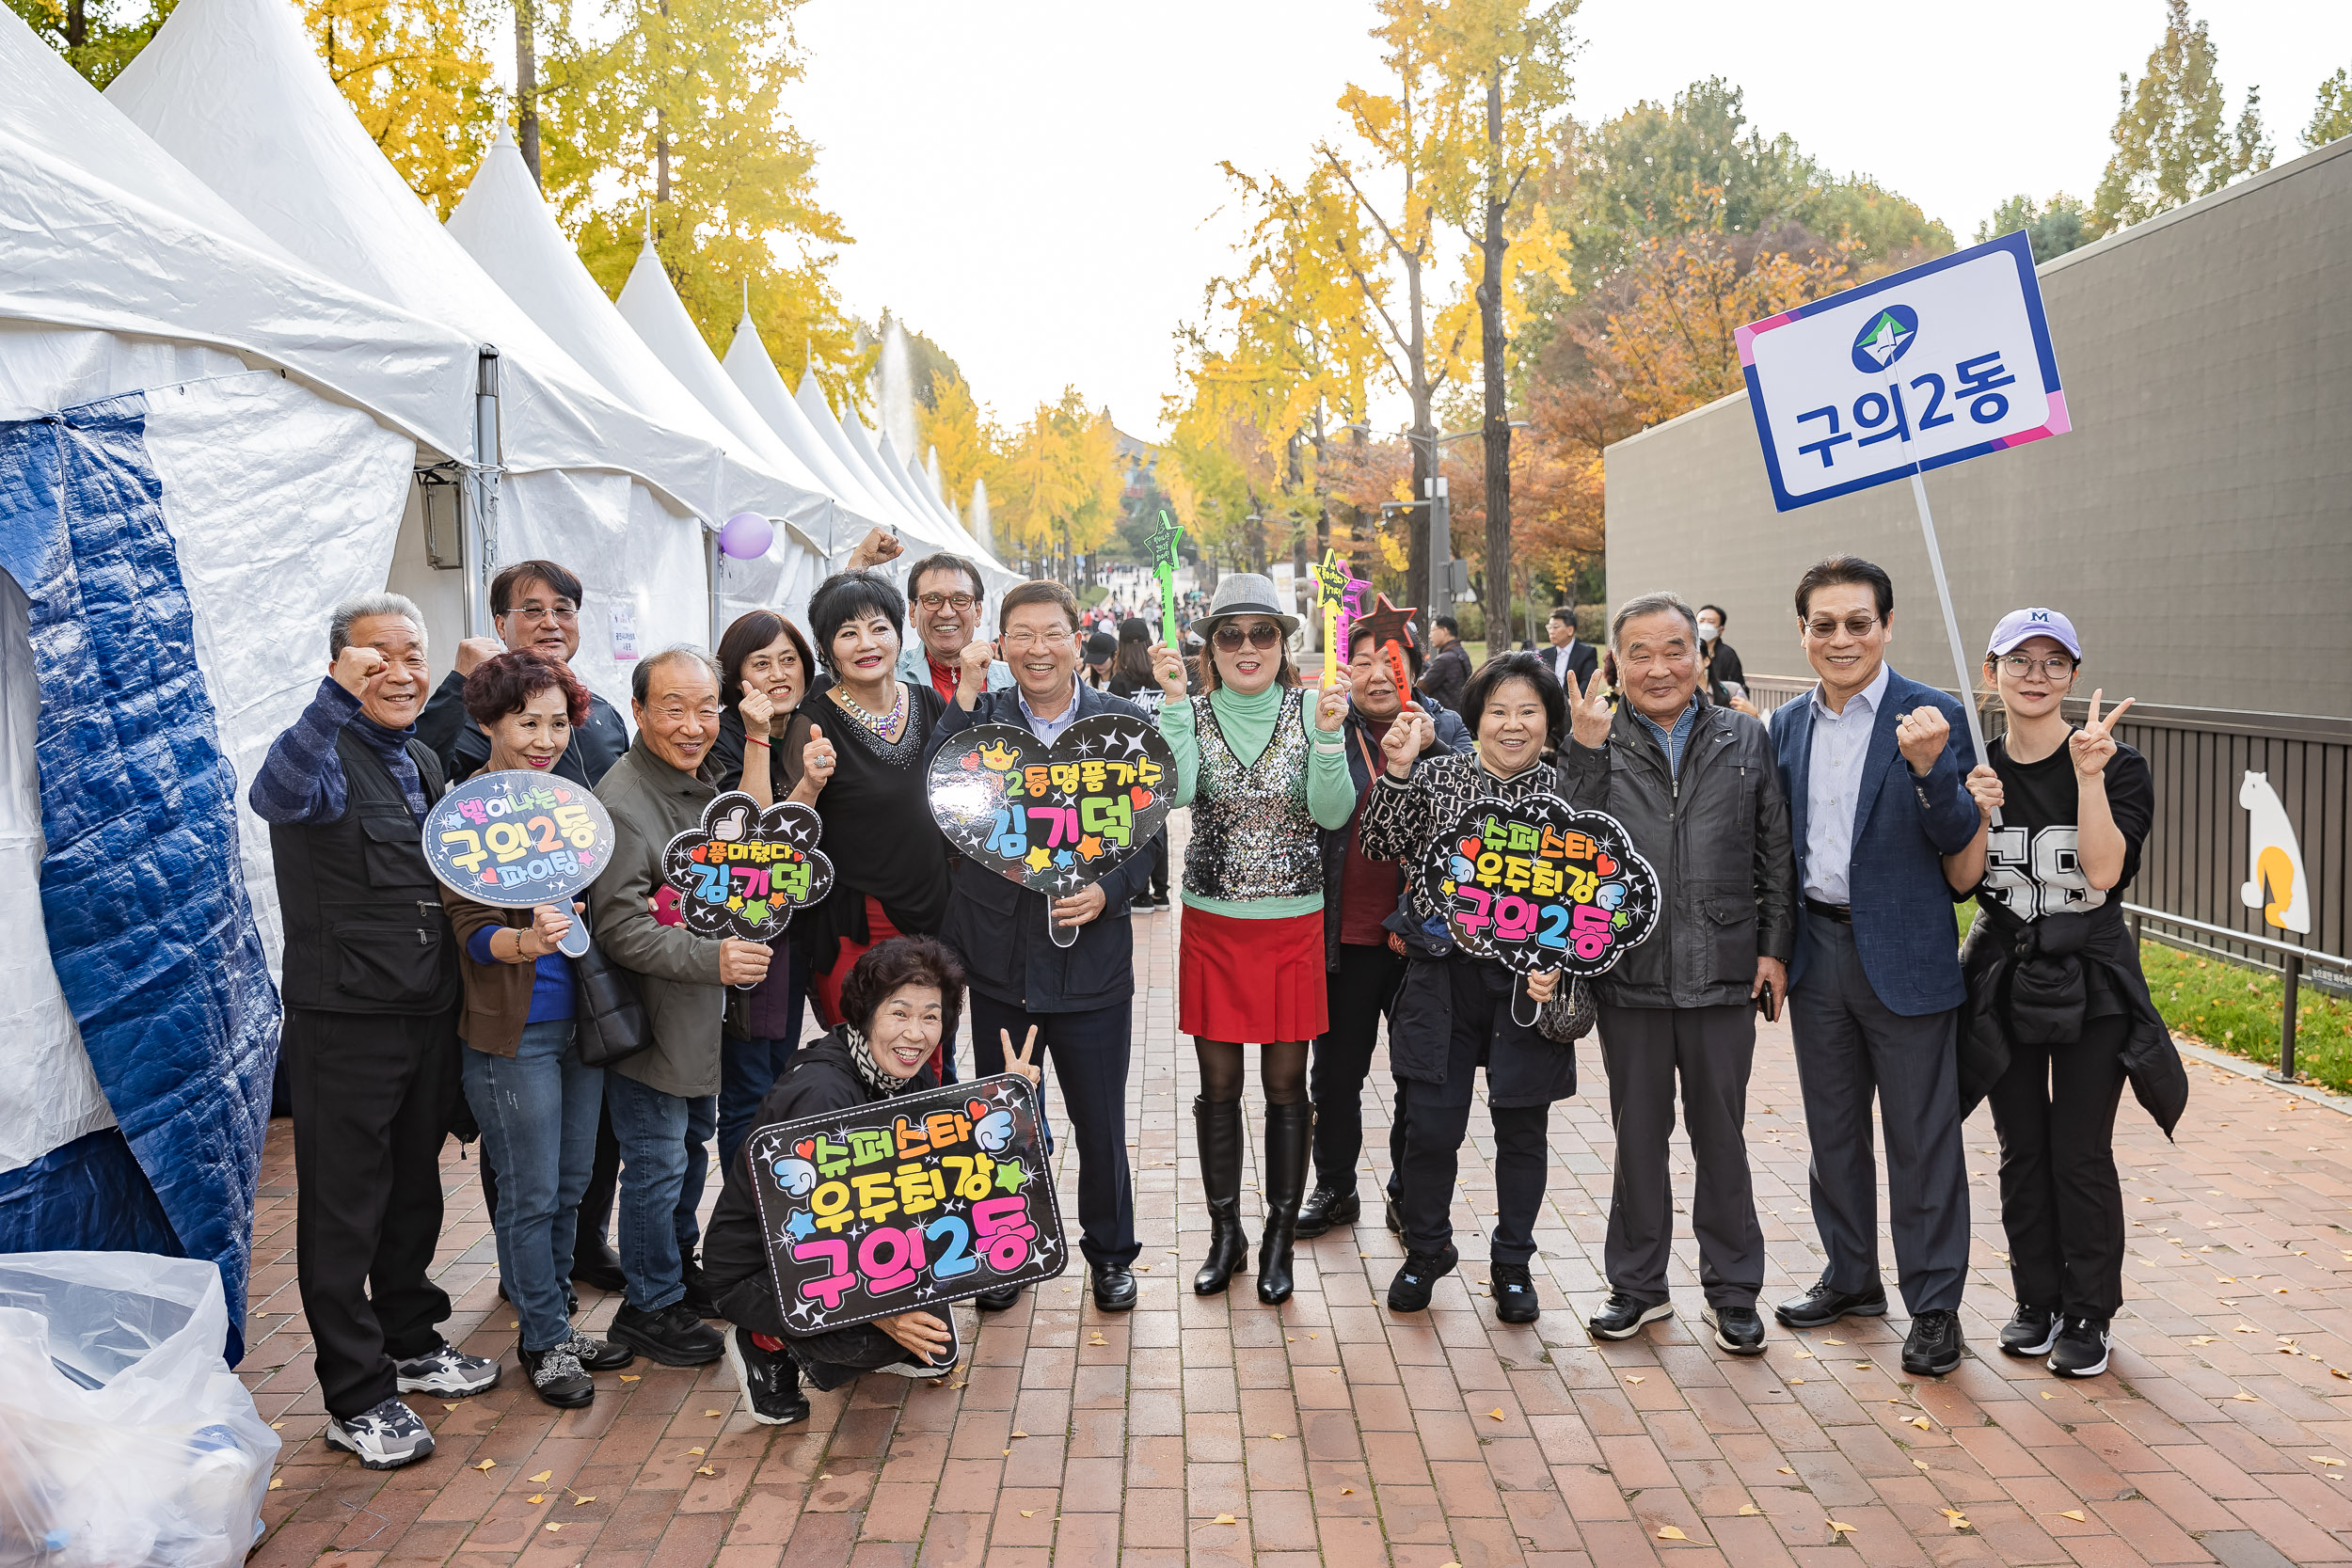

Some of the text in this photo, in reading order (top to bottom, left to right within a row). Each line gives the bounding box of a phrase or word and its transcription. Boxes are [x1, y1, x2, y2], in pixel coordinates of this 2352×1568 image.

[1796, 350, 2016, 468] 구의2동
[2030, 611, 2049, 623] M
[457, 786, 558, 826] 빛이나는
[985, 794, 1133, 857] 김기덕
[440, 804, 598, 873] 구의2동
[496, 849, 580, 888] 파이팅
[1483, 816, 1598, 861] 슈퍼스타
[690, 863, 812, 903] 김기덕
[1475, 851, 1599, 904] 우주최강
[1455, 885, 1613, 959] 구의2동
[816, 1113, 973, 1179] 슈퍼스타
[810, 1152, 995, 1233] 우주최강
[793, 1196, 1036, 1308] 구의2동
